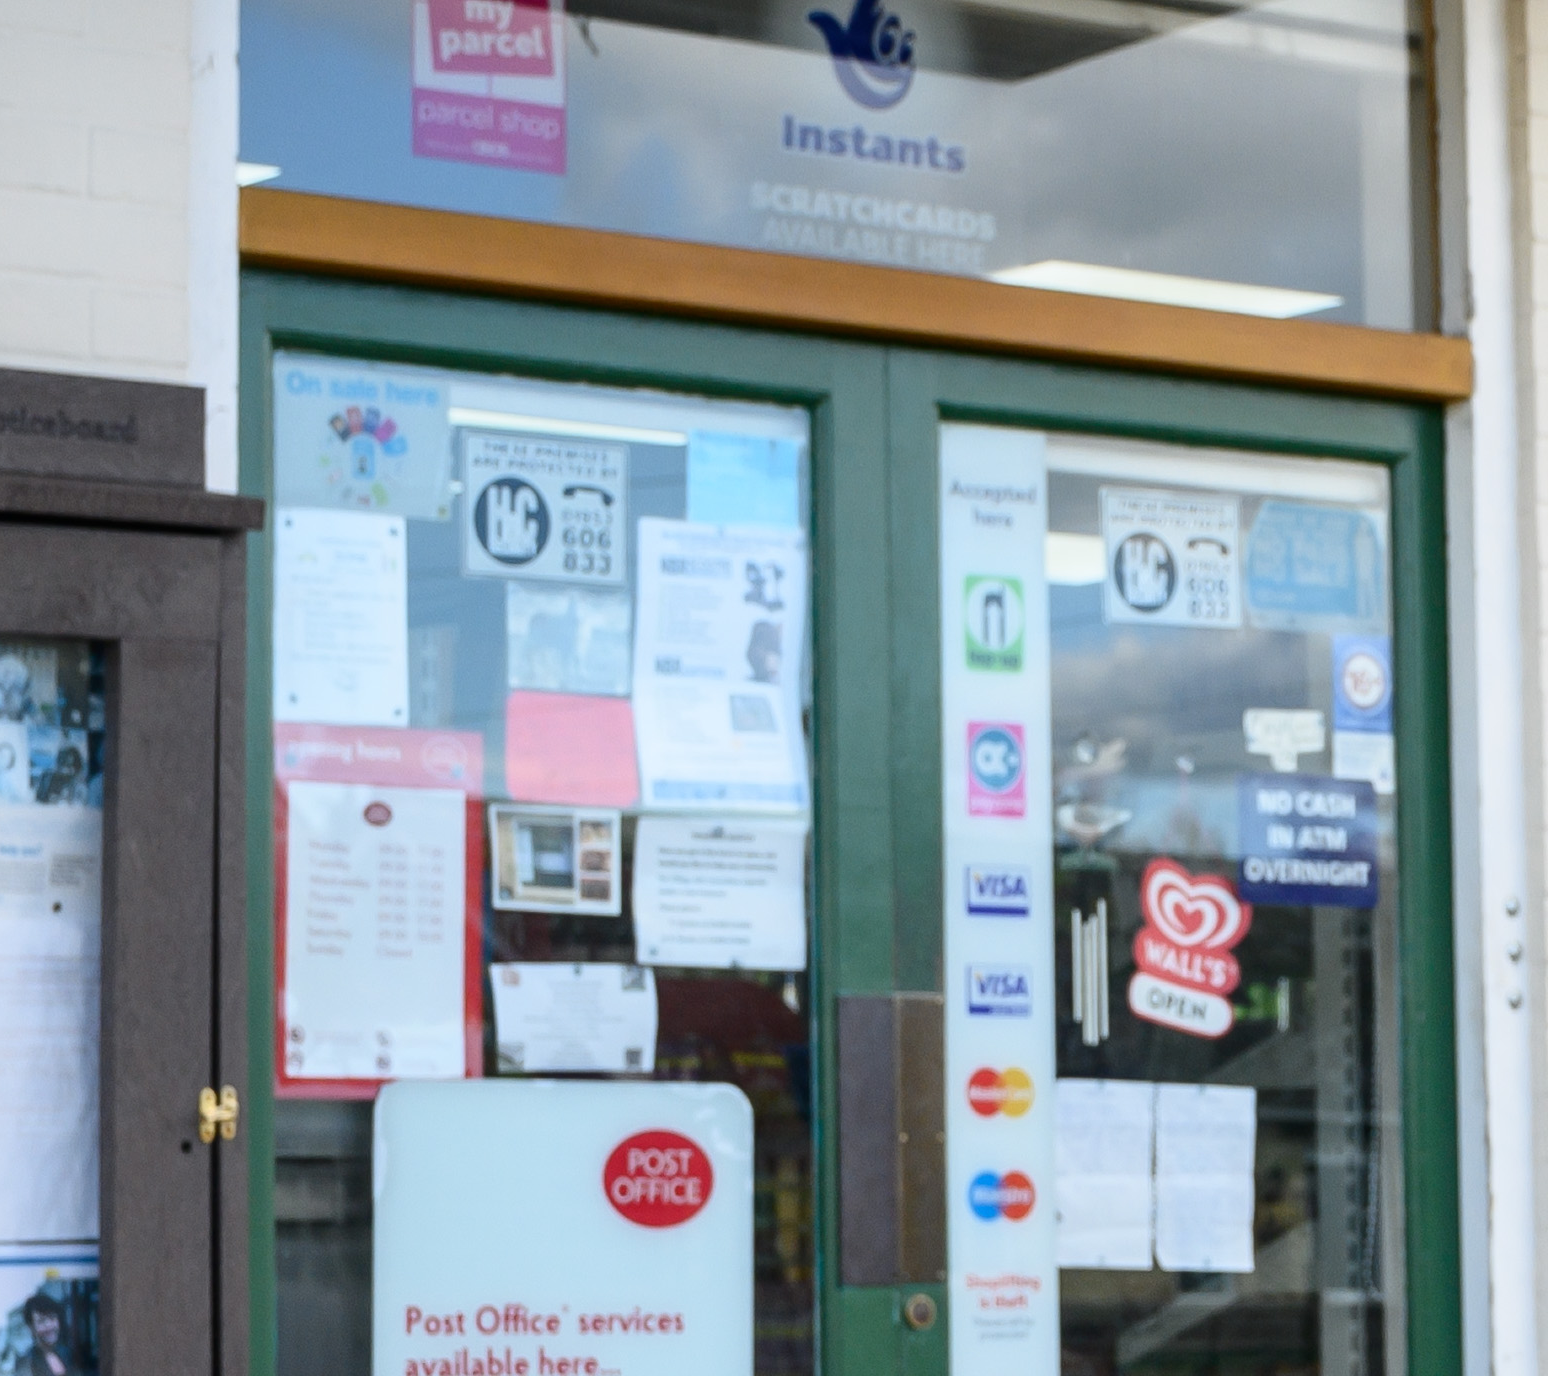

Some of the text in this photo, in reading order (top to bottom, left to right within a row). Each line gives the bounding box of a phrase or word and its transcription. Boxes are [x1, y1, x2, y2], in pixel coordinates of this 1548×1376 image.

[439, 28, 546, 62] parcel
[417, 100, 561, 140] parcel shop
[782, 114, 966, 173] Instants
[752, 181, 997, 242] SCRATCHCARDS
[285, 369, 440, 407] On sale here
[562, 527, 612, 549] 606
[1256, 789, 1356, 819] NO CASH
[1266, 824, 1348, 852] IN ATM
[973, 875, 1028, 897] VISA
[1243, 858, 1372, 888] OVERNIGHT
[1142, 939, 1228, 987] WALL'S
[974, 974, 1029, 997] VISA
[1146, 985, 1208, 1023] OPEN
[626, 1148, 692, 1177] POST
[611, 1176, 702, 1206] OFFICE
[404, 1305, 465, 1335] Post
[579, 1308, 685, 1334] services
